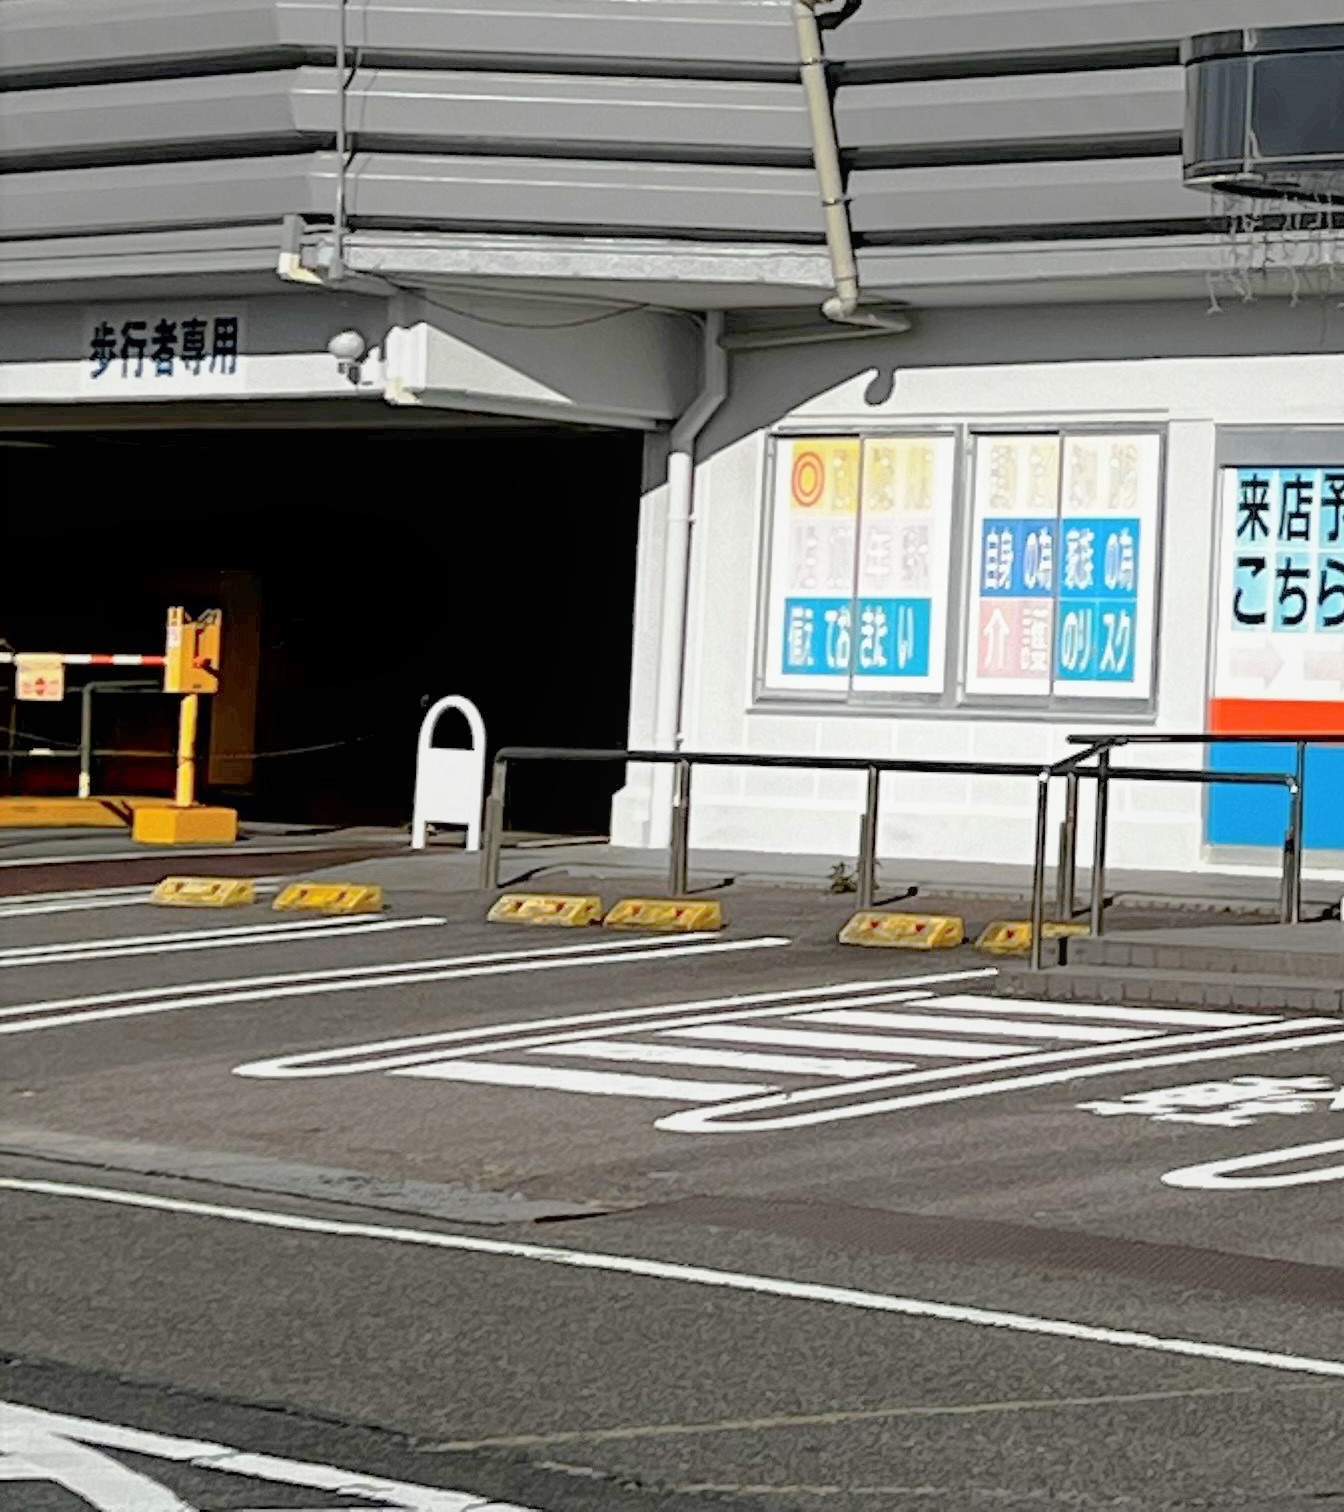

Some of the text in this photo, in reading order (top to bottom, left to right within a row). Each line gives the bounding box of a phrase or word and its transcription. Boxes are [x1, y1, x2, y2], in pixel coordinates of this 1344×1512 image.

[89, 317, 238, 378] 歩行者専用
